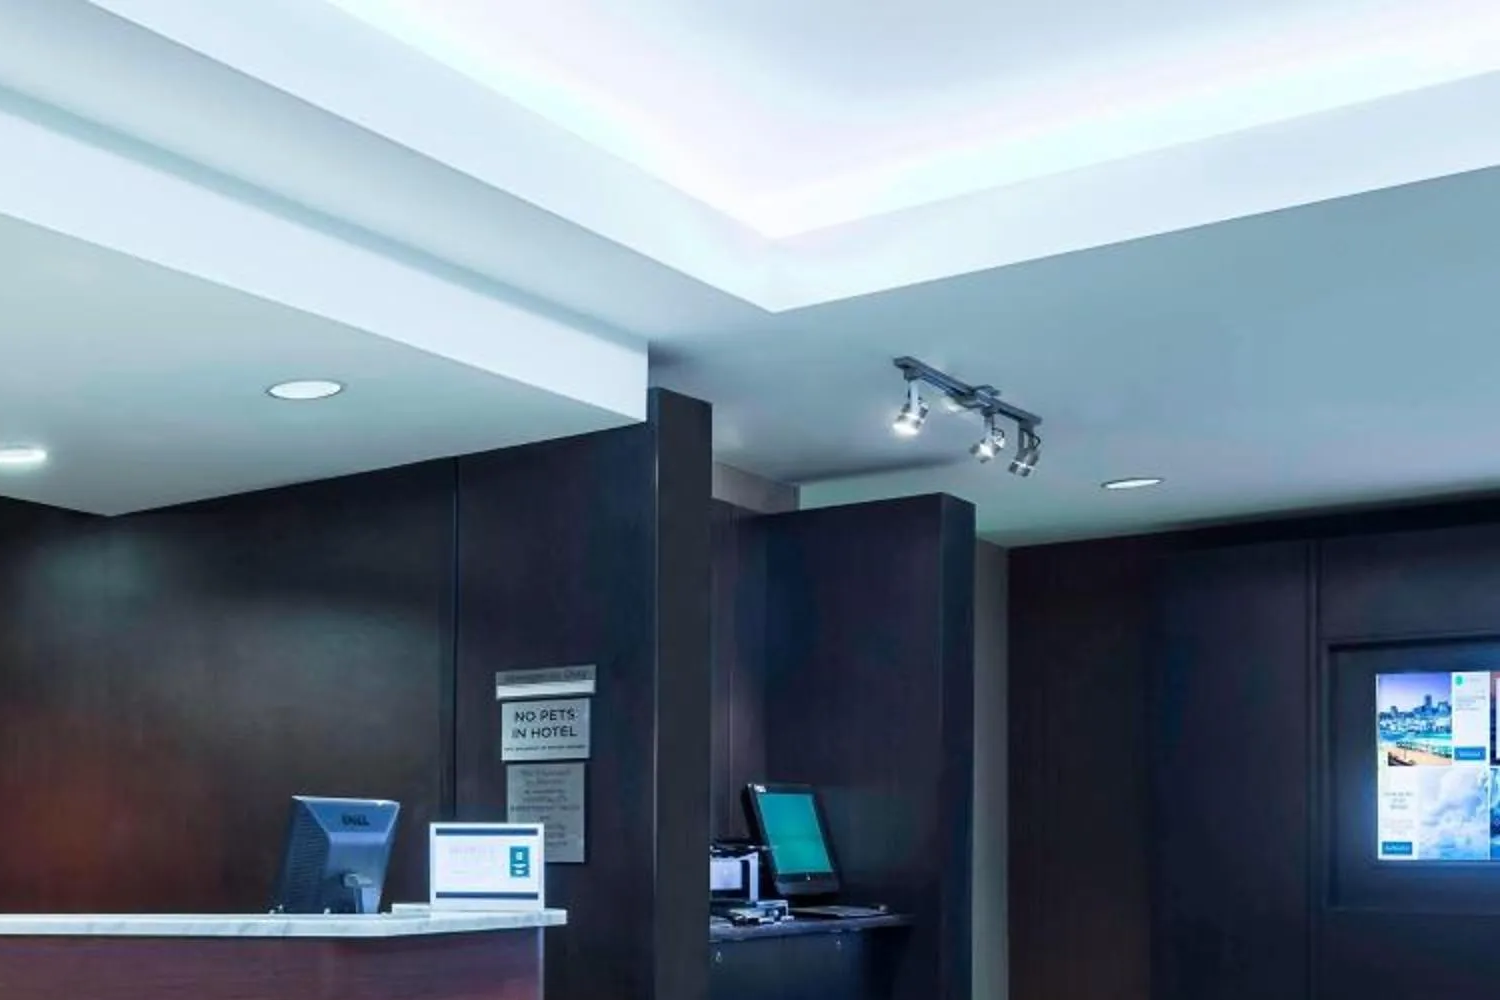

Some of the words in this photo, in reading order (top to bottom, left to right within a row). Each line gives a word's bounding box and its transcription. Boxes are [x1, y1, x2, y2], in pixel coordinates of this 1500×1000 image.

[514, 710, 537, 722] NO
[539, 708, 577, 722] PETS
[511, 728, 526, 739] IN
[531, 726, 578, 739] HOTEL
